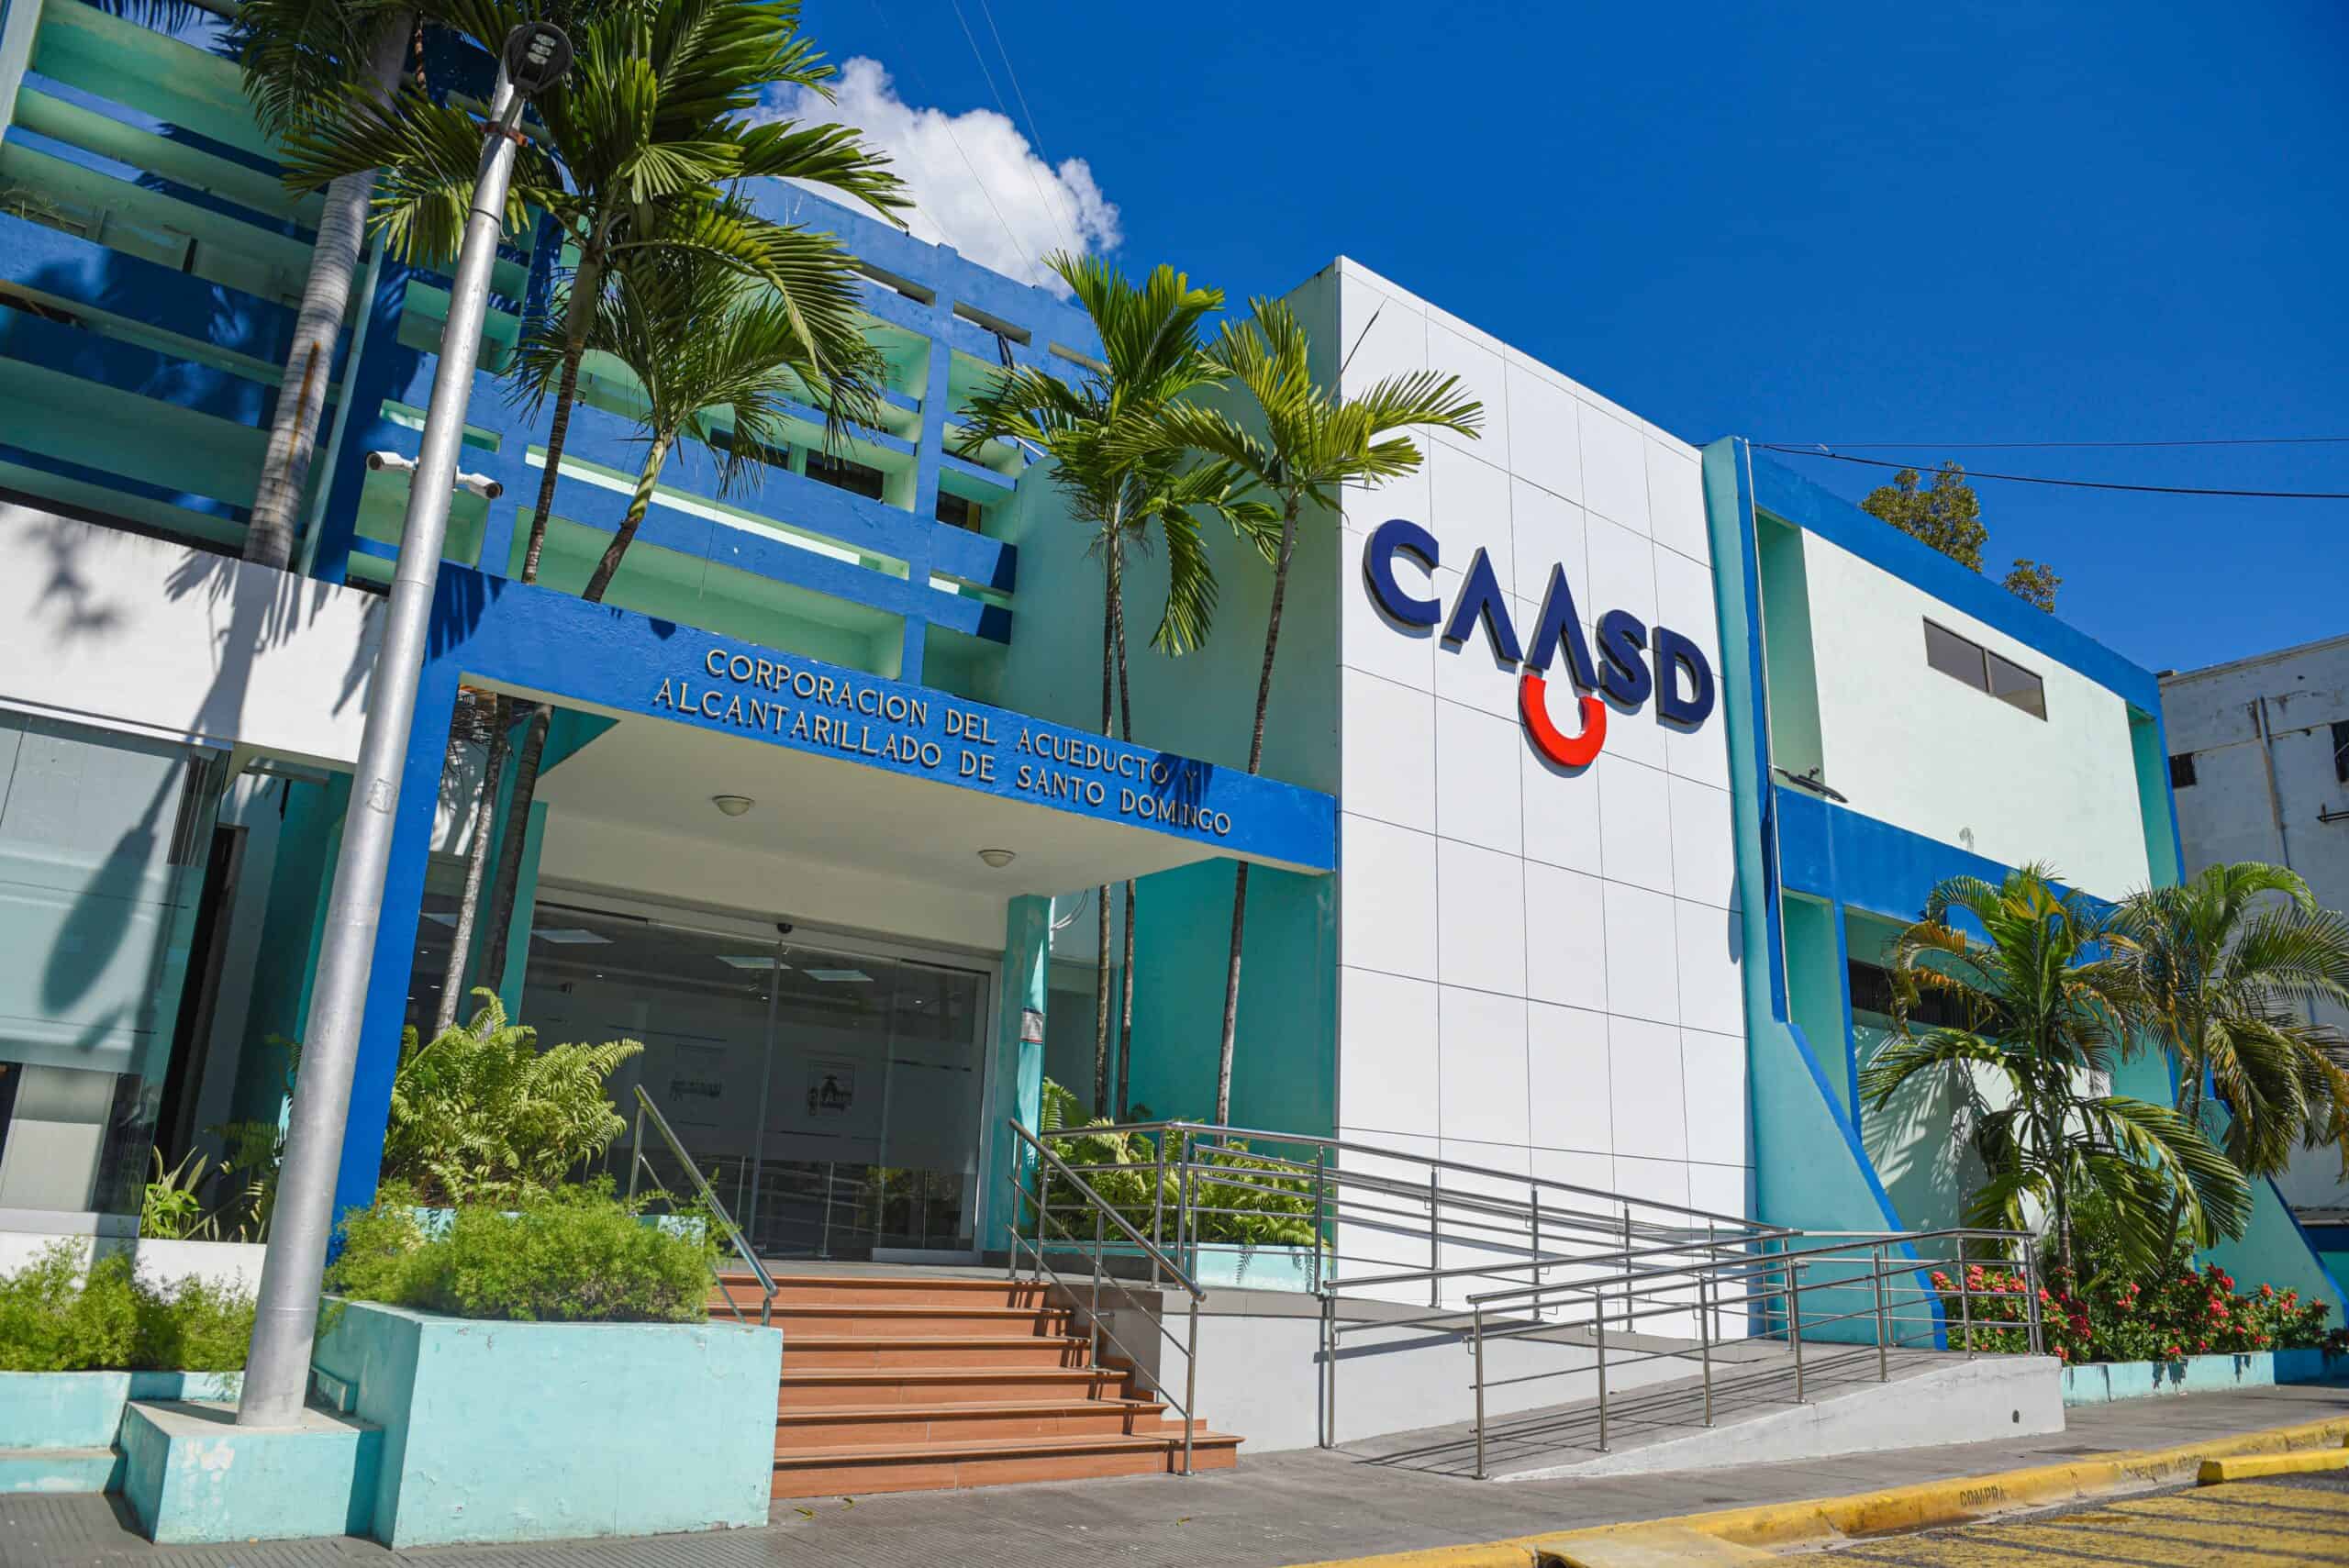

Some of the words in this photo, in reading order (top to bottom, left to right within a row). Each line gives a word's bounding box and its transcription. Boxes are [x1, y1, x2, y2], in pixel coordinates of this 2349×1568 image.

[1363, 518, 1715, 729] CAASD
[652, 677, 942, 768] ALCANTARILLADO
[959, 750, 996, 782] DE
[1016, 764, 1105, 805] SANTO
[1120, 787, 1231, 836] DOMINGO
[706, 649, 928, 728] CORPORACION
[945, 707, 998, 745] DEL
[1016, 728, 1168, 785] ACUEDUCTO
[1185, 770, 1197, 793] Y
